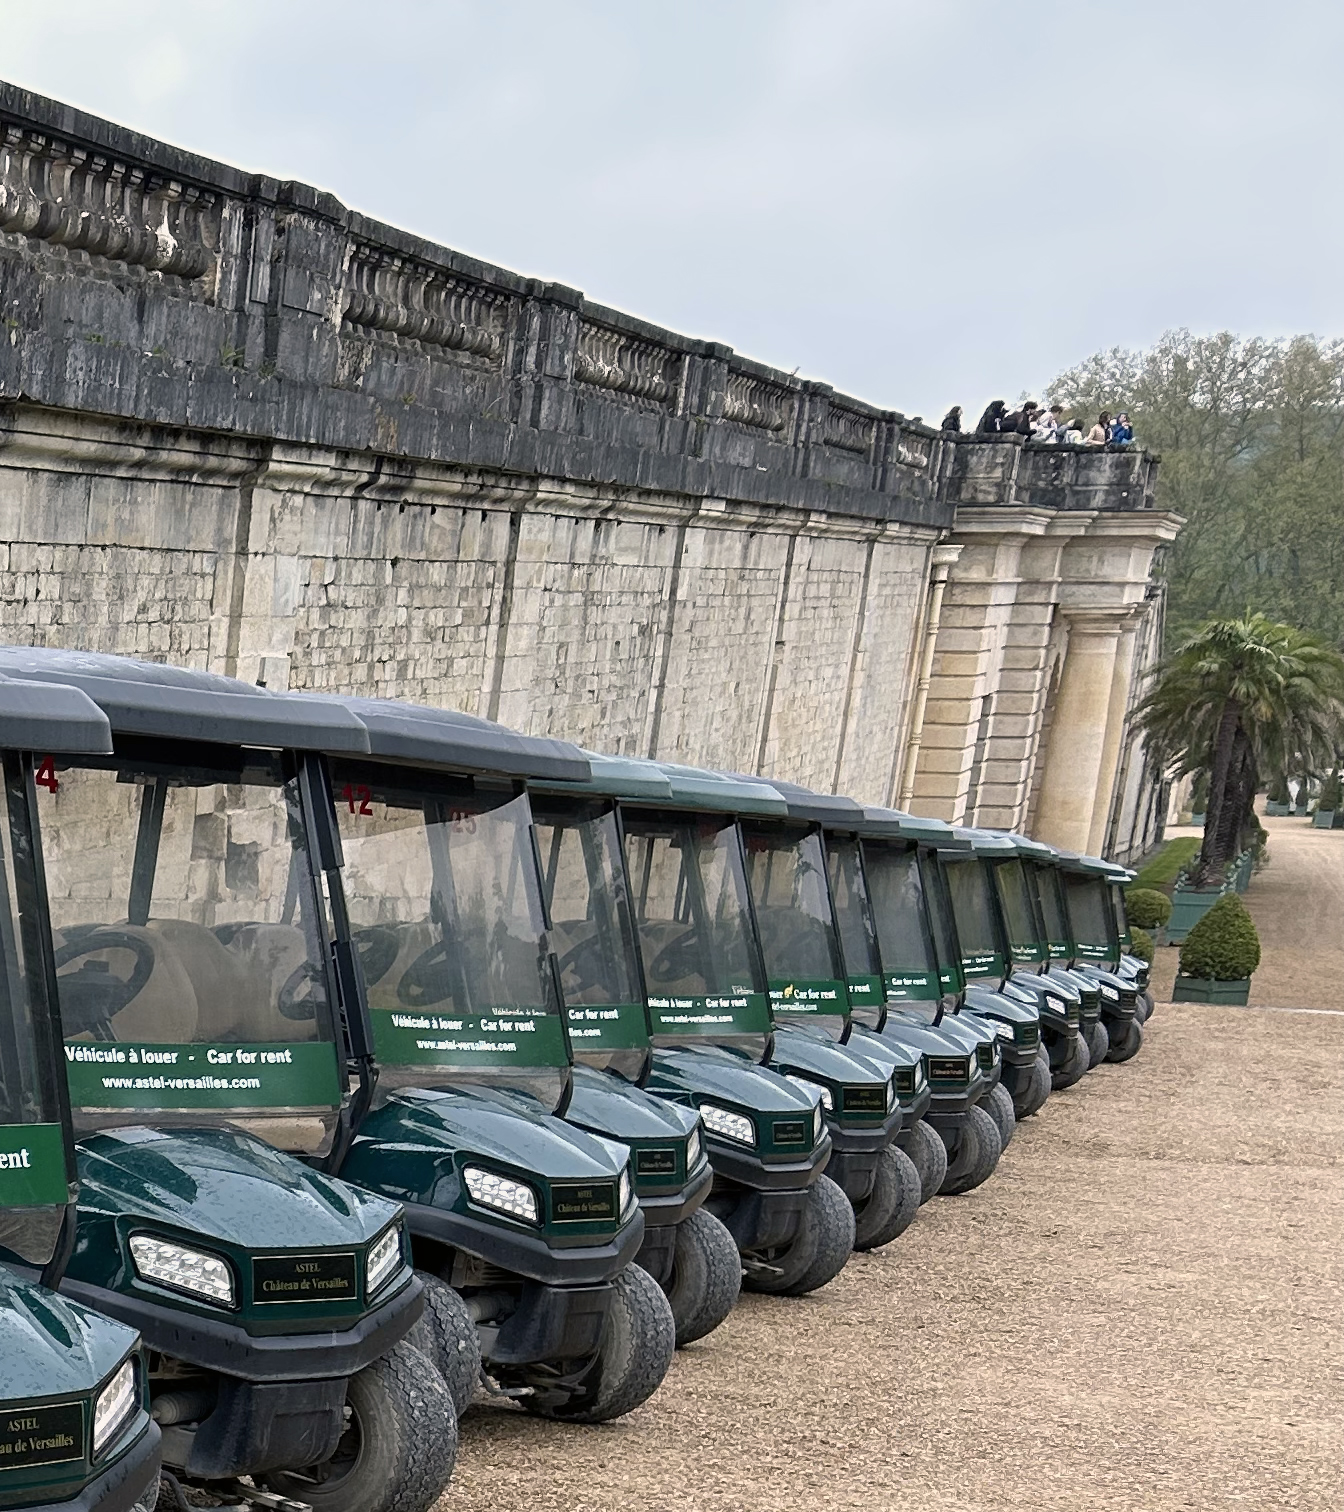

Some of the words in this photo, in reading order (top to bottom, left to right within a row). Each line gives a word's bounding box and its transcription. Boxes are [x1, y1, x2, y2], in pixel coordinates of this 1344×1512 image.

[35, 754, 59, 794] 4
[342, 784, 373, 816] 12
[480, 1018, 498, 1032] Car
[515, 1019, 536, 1032] rent
[64, 1045, 126, 1063] Véhicule
[128, 1047, 139, 1063] à
[141, 1048, 179, 1064] louer
[206, 1049, 233, 1064] Car
[235, 1049, 258, 1064] for
[260, 1048, 292, 1063] rent
[101, 1075, 261, 1089] www.astel-versailles.com
[295, 1262, 321, 1273] ASTEL
[262, 1279, 299, 1291] Château
[300, 1278, 310, 1290] de
[311, 1277, 348, 1289] Versailles
[7, 1417, 40, 1432] ASTEL
[14, 1438, 28, 1453] de
[29, 1433, 74, 1450] Versailles
